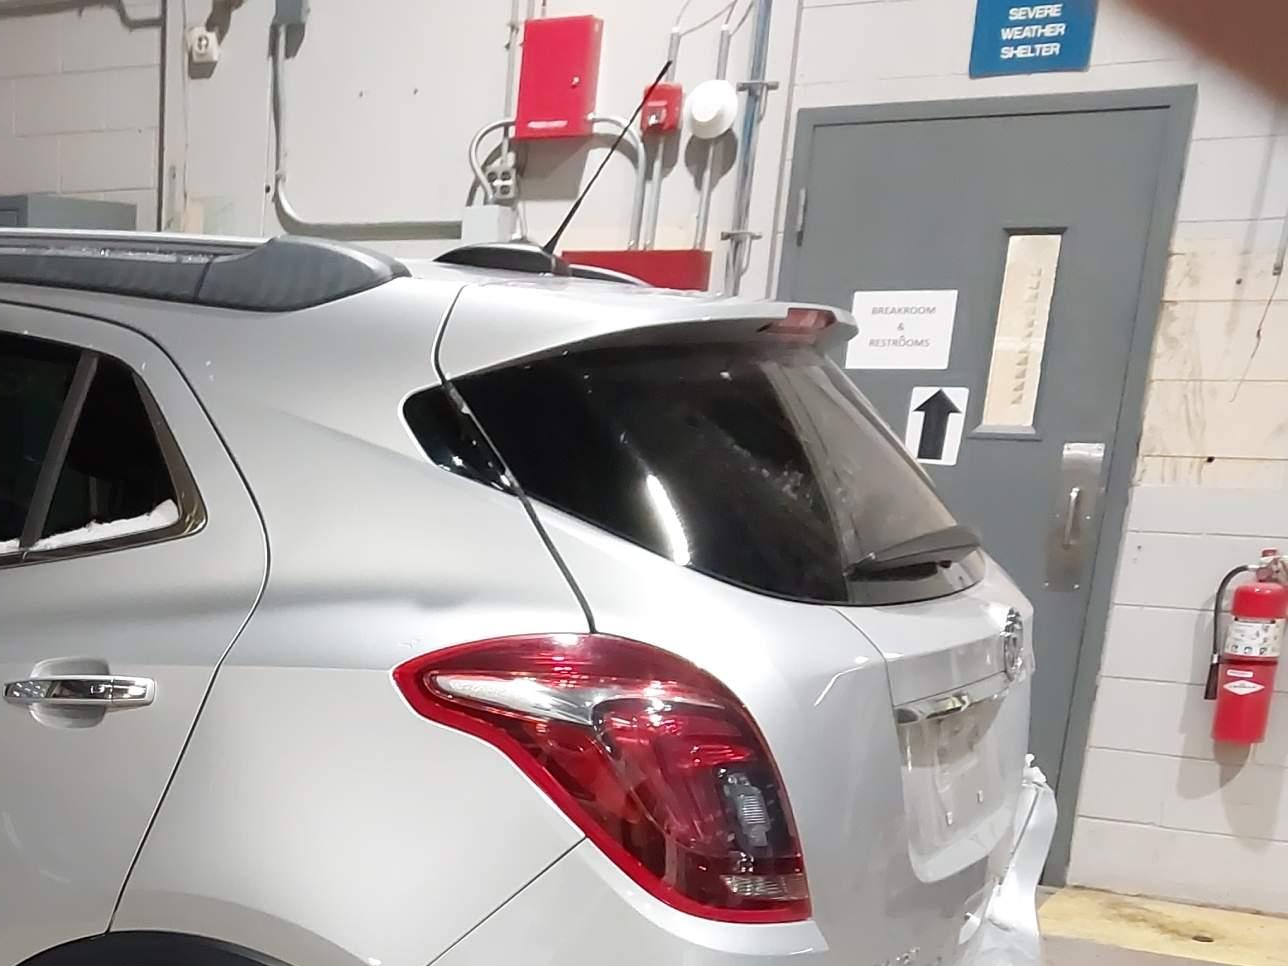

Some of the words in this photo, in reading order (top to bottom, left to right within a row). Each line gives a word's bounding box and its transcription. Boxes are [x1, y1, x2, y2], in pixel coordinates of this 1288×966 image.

[1008, 4, 1063, 20] SEVERE
[1000, 23, 1066, 40] WEATHER
[1000, 43, 1061, 59] SHELTER
[871, 306, 936, 315] BREAKROOM
[897, 322, 904, 331] &
[868, 338, 931, 347] RESTROOMS
